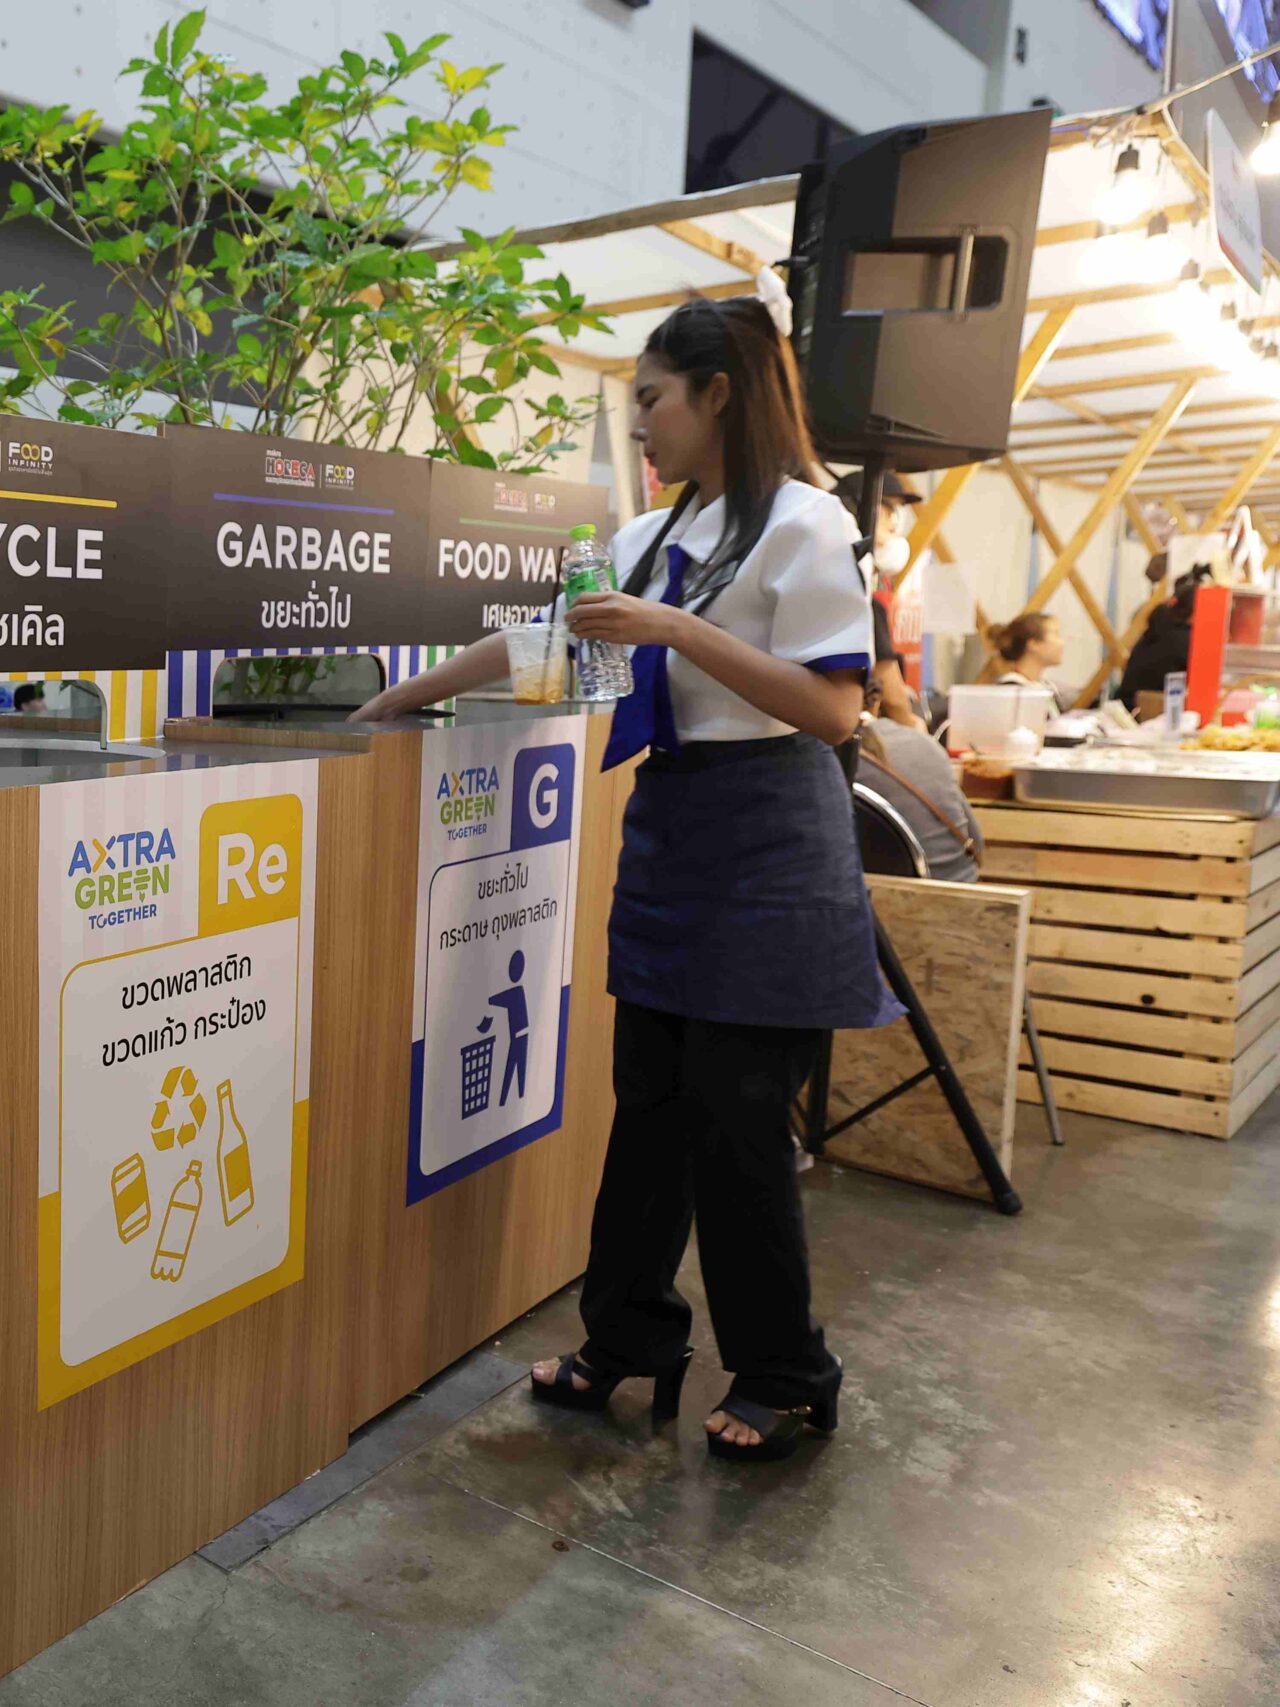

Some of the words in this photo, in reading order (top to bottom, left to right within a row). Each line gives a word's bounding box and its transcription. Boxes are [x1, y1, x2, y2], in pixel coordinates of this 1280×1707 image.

[8, 441, 54, 462] FOOD
[8, 458, 54, 471] INFINITY
[325, 464, 356, 480] FOOD
[216, 521, 392, 574] GARBAGE
[438, 538, 512, 581] FOOD
[261, 580, 352, 630] ขยะทั่วไป
[437, 765, 500, 800] AXTRA
[528, 762, 560, 830] G
[439, 793, 496, 826] GREEN
[447, 823, 488, 841] TOGETHER
[67, 827, 176, 878] AXTRA
[217, 832, 288, 906] Re
[74, 863, 170, 911] GREEN
[478, 862, 529, 900] ขยะทั่วไป
[88, 903, 157, 930] TOGETHER
[439, 921, 489, 950] กระดาษ
[491, 897, 558, 942] ถุงพลาสติก
[121, 953, 252, 1011] ขวดพลาสติก
[101, 1016, 187, 1068] ขวดแก้ว
[193, 996, 267, 1041] กระป๋อง
